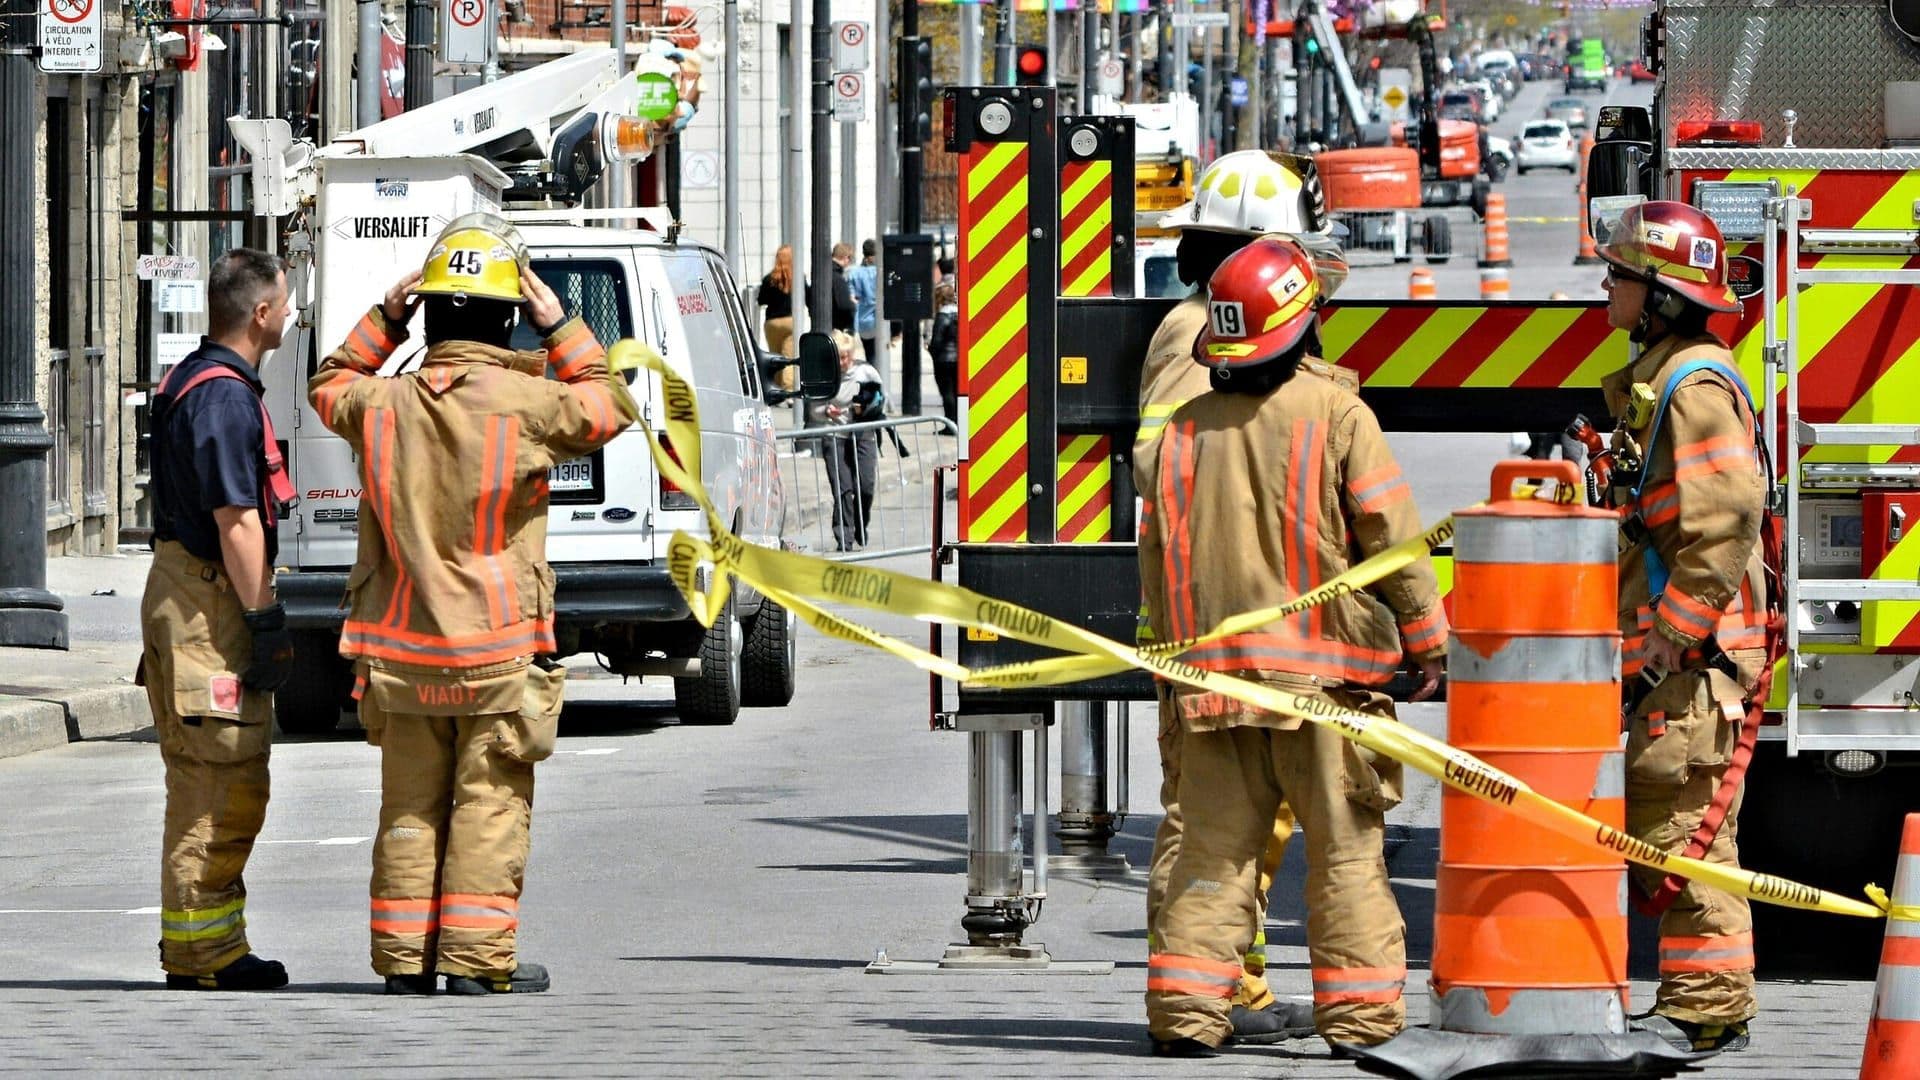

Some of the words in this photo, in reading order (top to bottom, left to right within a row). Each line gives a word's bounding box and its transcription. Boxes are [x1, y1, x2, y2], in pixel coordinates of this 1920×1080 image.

[45, 26, 92, 35] CIRCULATION
[53, 35, 72, 46] VÉLO
[44, 47, 82, 56] INTERDITE
[354, 216, 430, 239] VERSALIFT
[1647, 228, 1664, 242] 6
[448, 249, 482, 276] 45
[1283, 279, 1298, 294] 6
[1213, 304, 1241, 335] 19
[547, 463, 590, 481] 1309
[306, 488, 363, 499] SAUV
[1135, 649, 1209, 682] CAUTION
[1293, 695, 1368, 735] CAUTION
[1443, 756, 1518, 806] CAUTION
[1595, 824, 1669, 867] CAUTION
[1747, 872, 1822, 906] CAUTION
